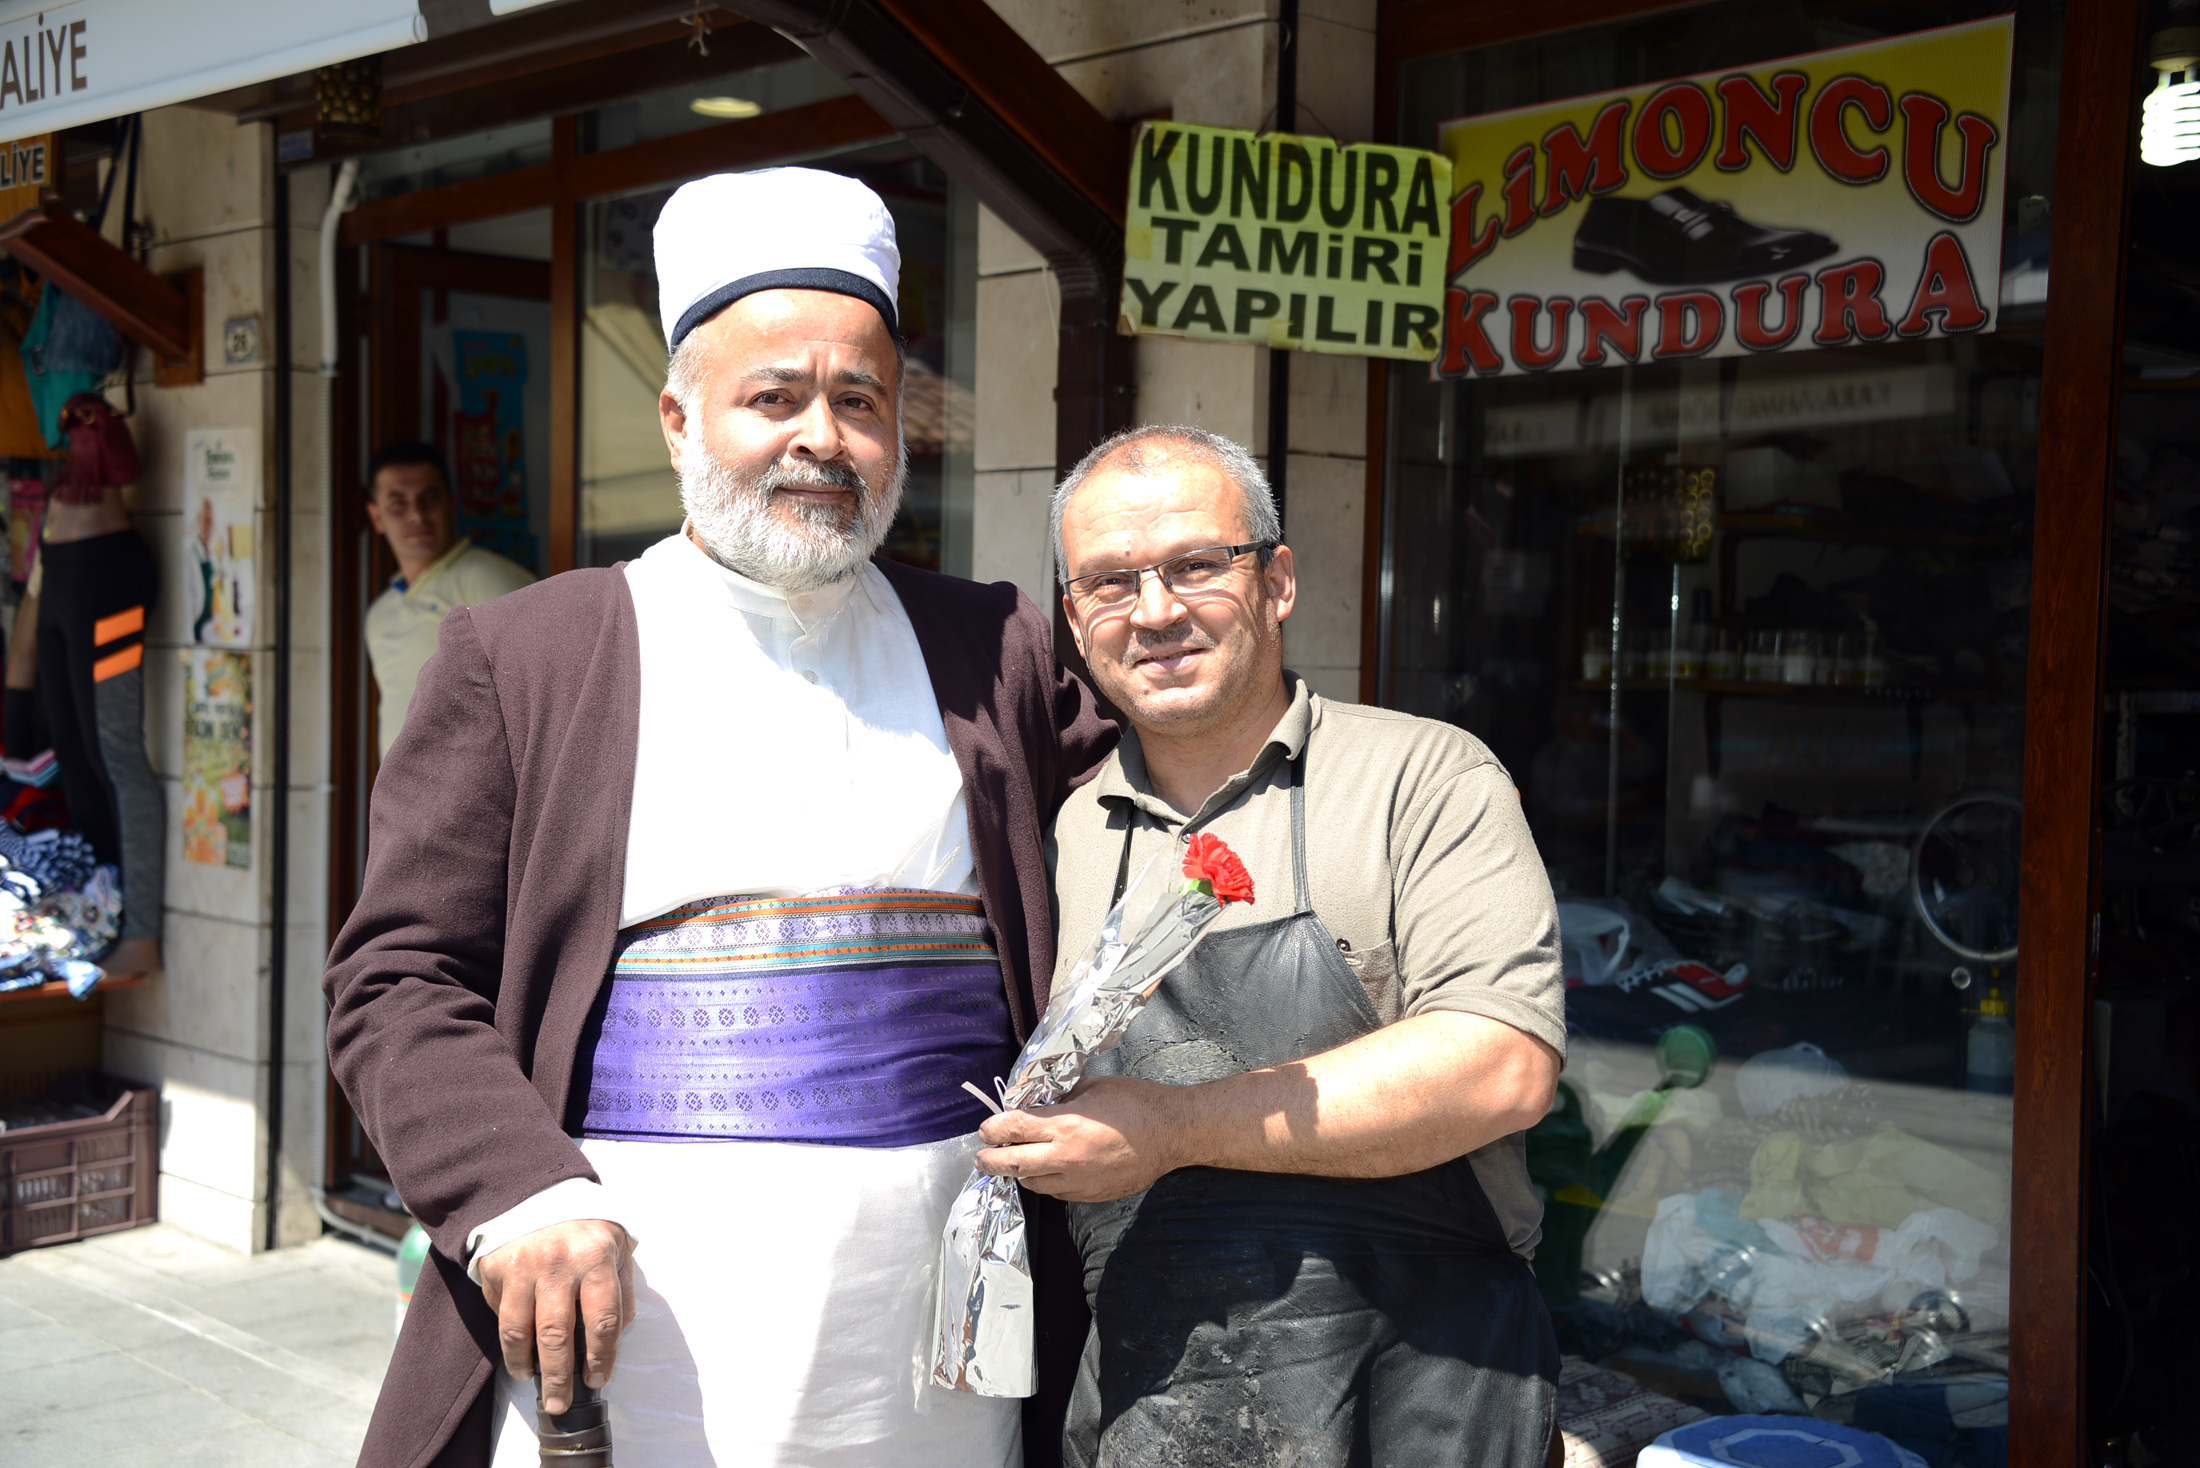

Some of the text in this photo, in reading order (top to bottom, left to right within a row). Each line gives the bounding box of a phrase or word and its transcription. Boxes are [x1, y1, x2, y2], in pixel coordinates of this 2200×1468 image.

[0, 12, 88, 110] ALİYE
[1138, 127, 1441, 237] KUNDURA
[1125, 278, 1440, 350] YAPILIR
[1437, 231, 1988, 379] KUNDURA
